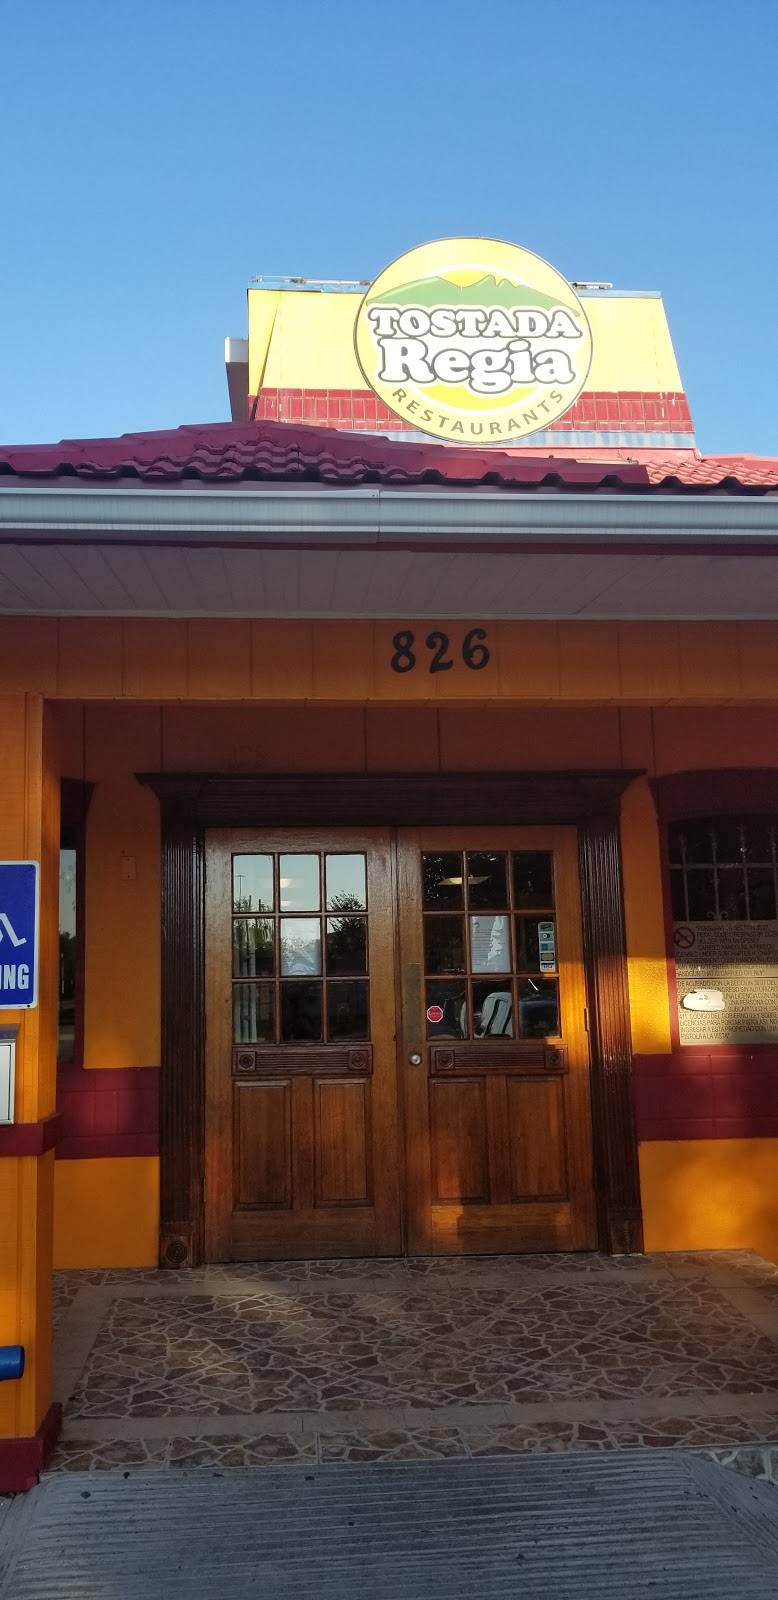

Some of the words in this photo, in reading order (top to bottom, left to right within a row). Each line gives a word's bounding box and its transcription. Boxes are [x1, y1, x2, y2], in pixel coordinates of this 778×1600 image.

[368, 307, 583, 338] TOSTADA
[377, 337, 576, 394] Regia
[392, 388, 563, 436] RESTAURANTS
[391, 628, 490, 674] 826
